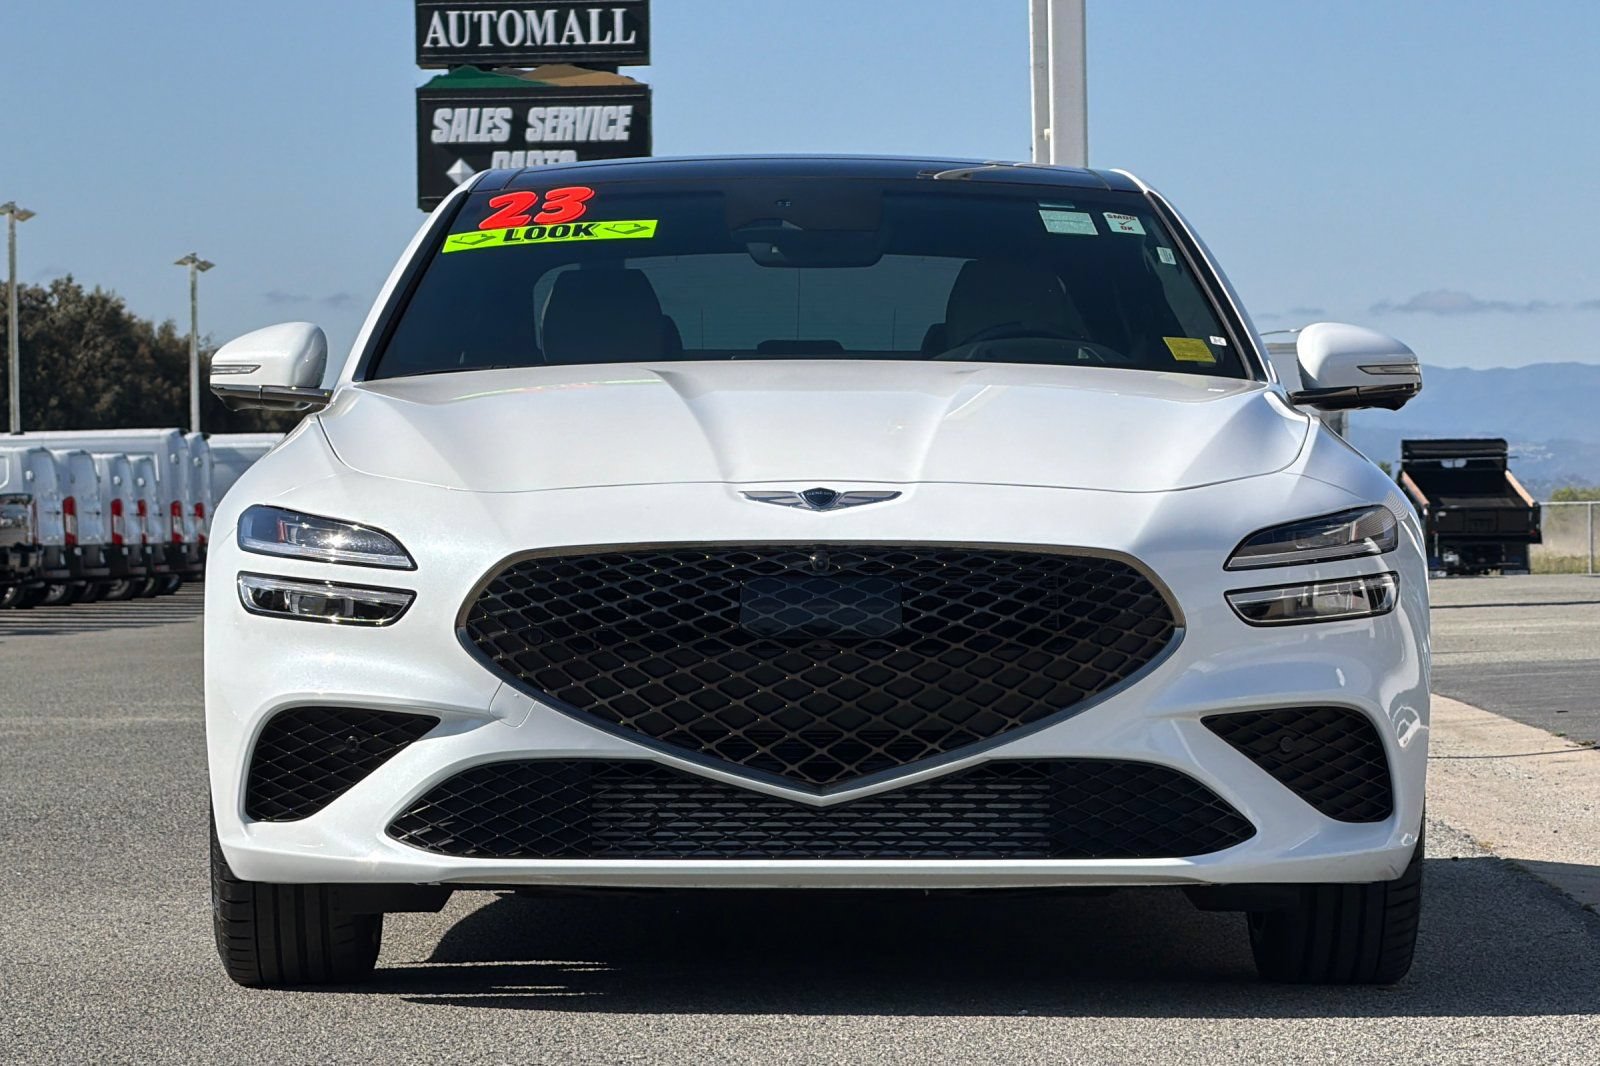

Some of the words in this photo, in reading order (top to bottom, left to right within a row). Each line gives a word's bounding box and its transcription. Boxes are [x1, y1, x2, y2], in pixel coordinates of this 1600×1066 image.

[422, 8, 636, 48] AUTOMALL
[431, 106, 513, 143] SALES
[525, 105, 633, 143] SERVICE
[478, 186, 595, 230] 23
[503, 222, 600, 243] LOOK
